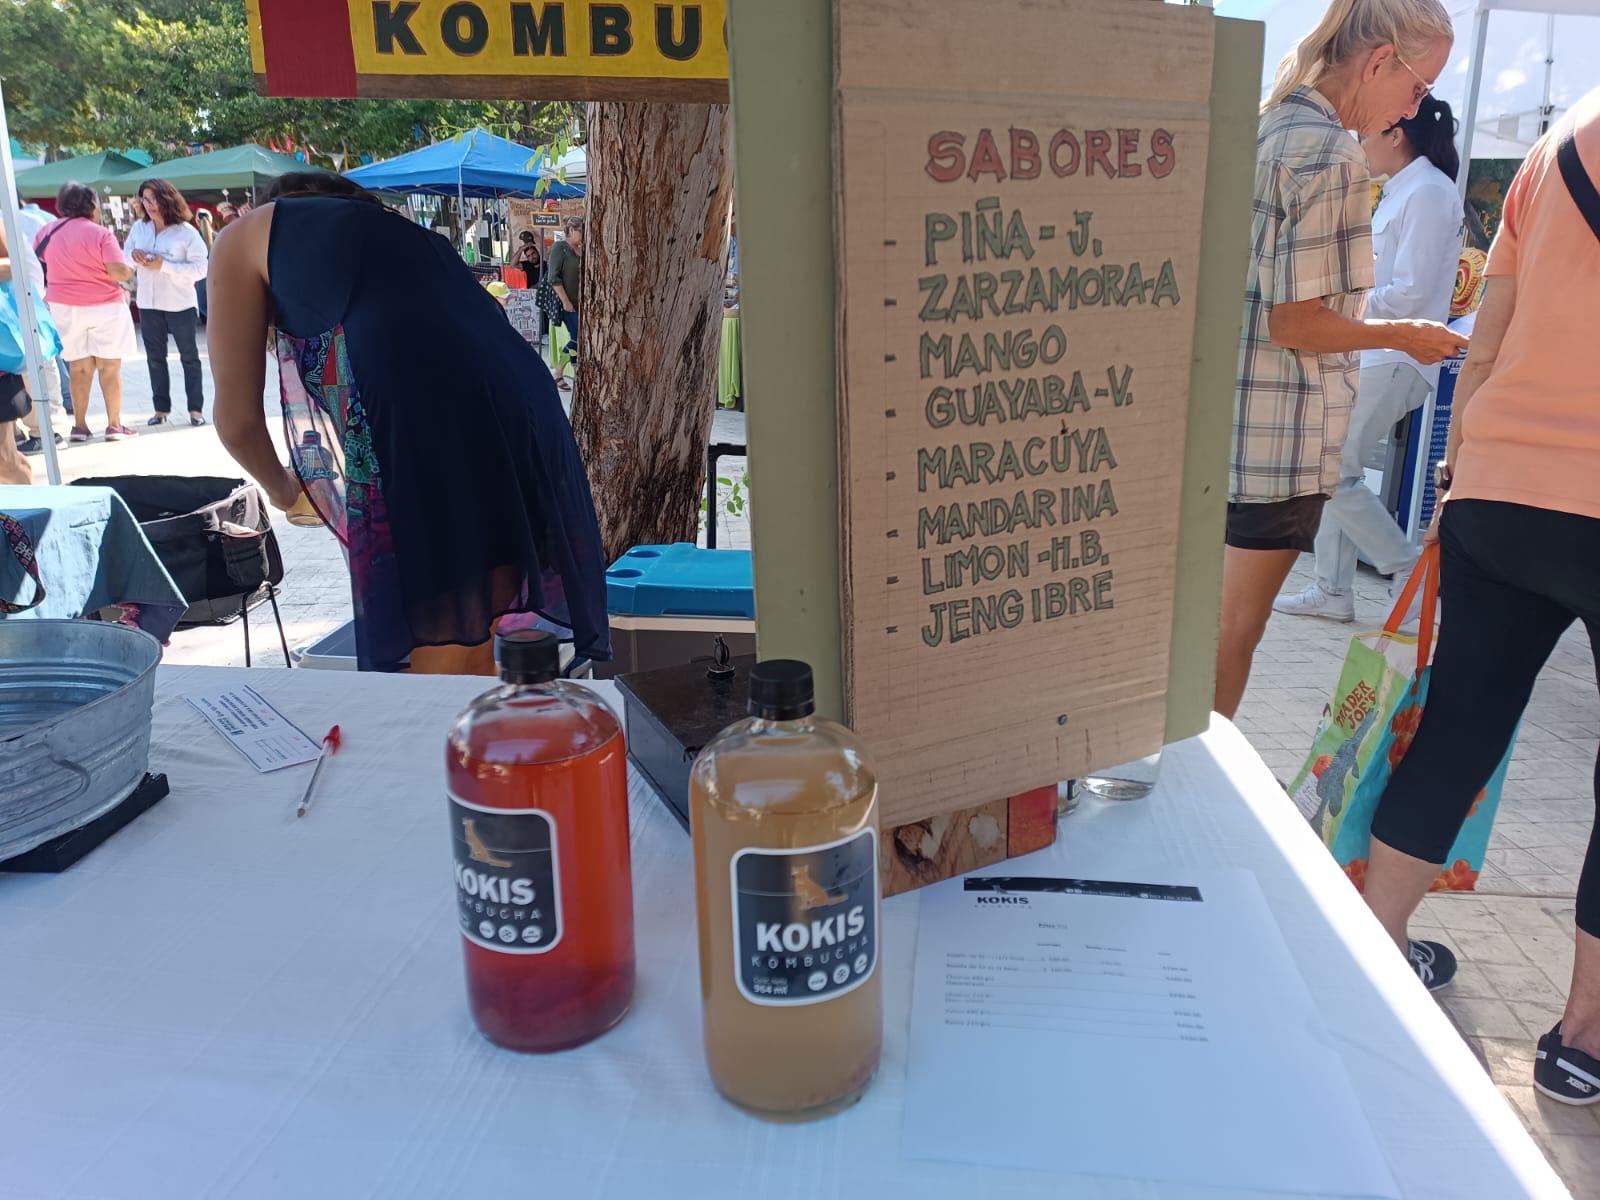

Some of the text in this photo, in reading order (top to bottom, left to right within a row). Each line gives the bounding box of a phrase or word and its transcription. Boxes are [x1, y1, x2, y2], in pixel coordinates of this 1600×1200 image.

[372, 1, 729, 61] KOMBU
[924, 126, 1176, 183] SABORES
[919, 324, 1067, 379] MANGO
[917, 479, 1119, 549] MANDARINA
[921, 570, 1114, 647] JENGIBRE
[976, 896, 1030, 905] KOKIS
[751, 934, 868, 969] KOMBUCHA
[756, 905, 865, 953] KOKIS
